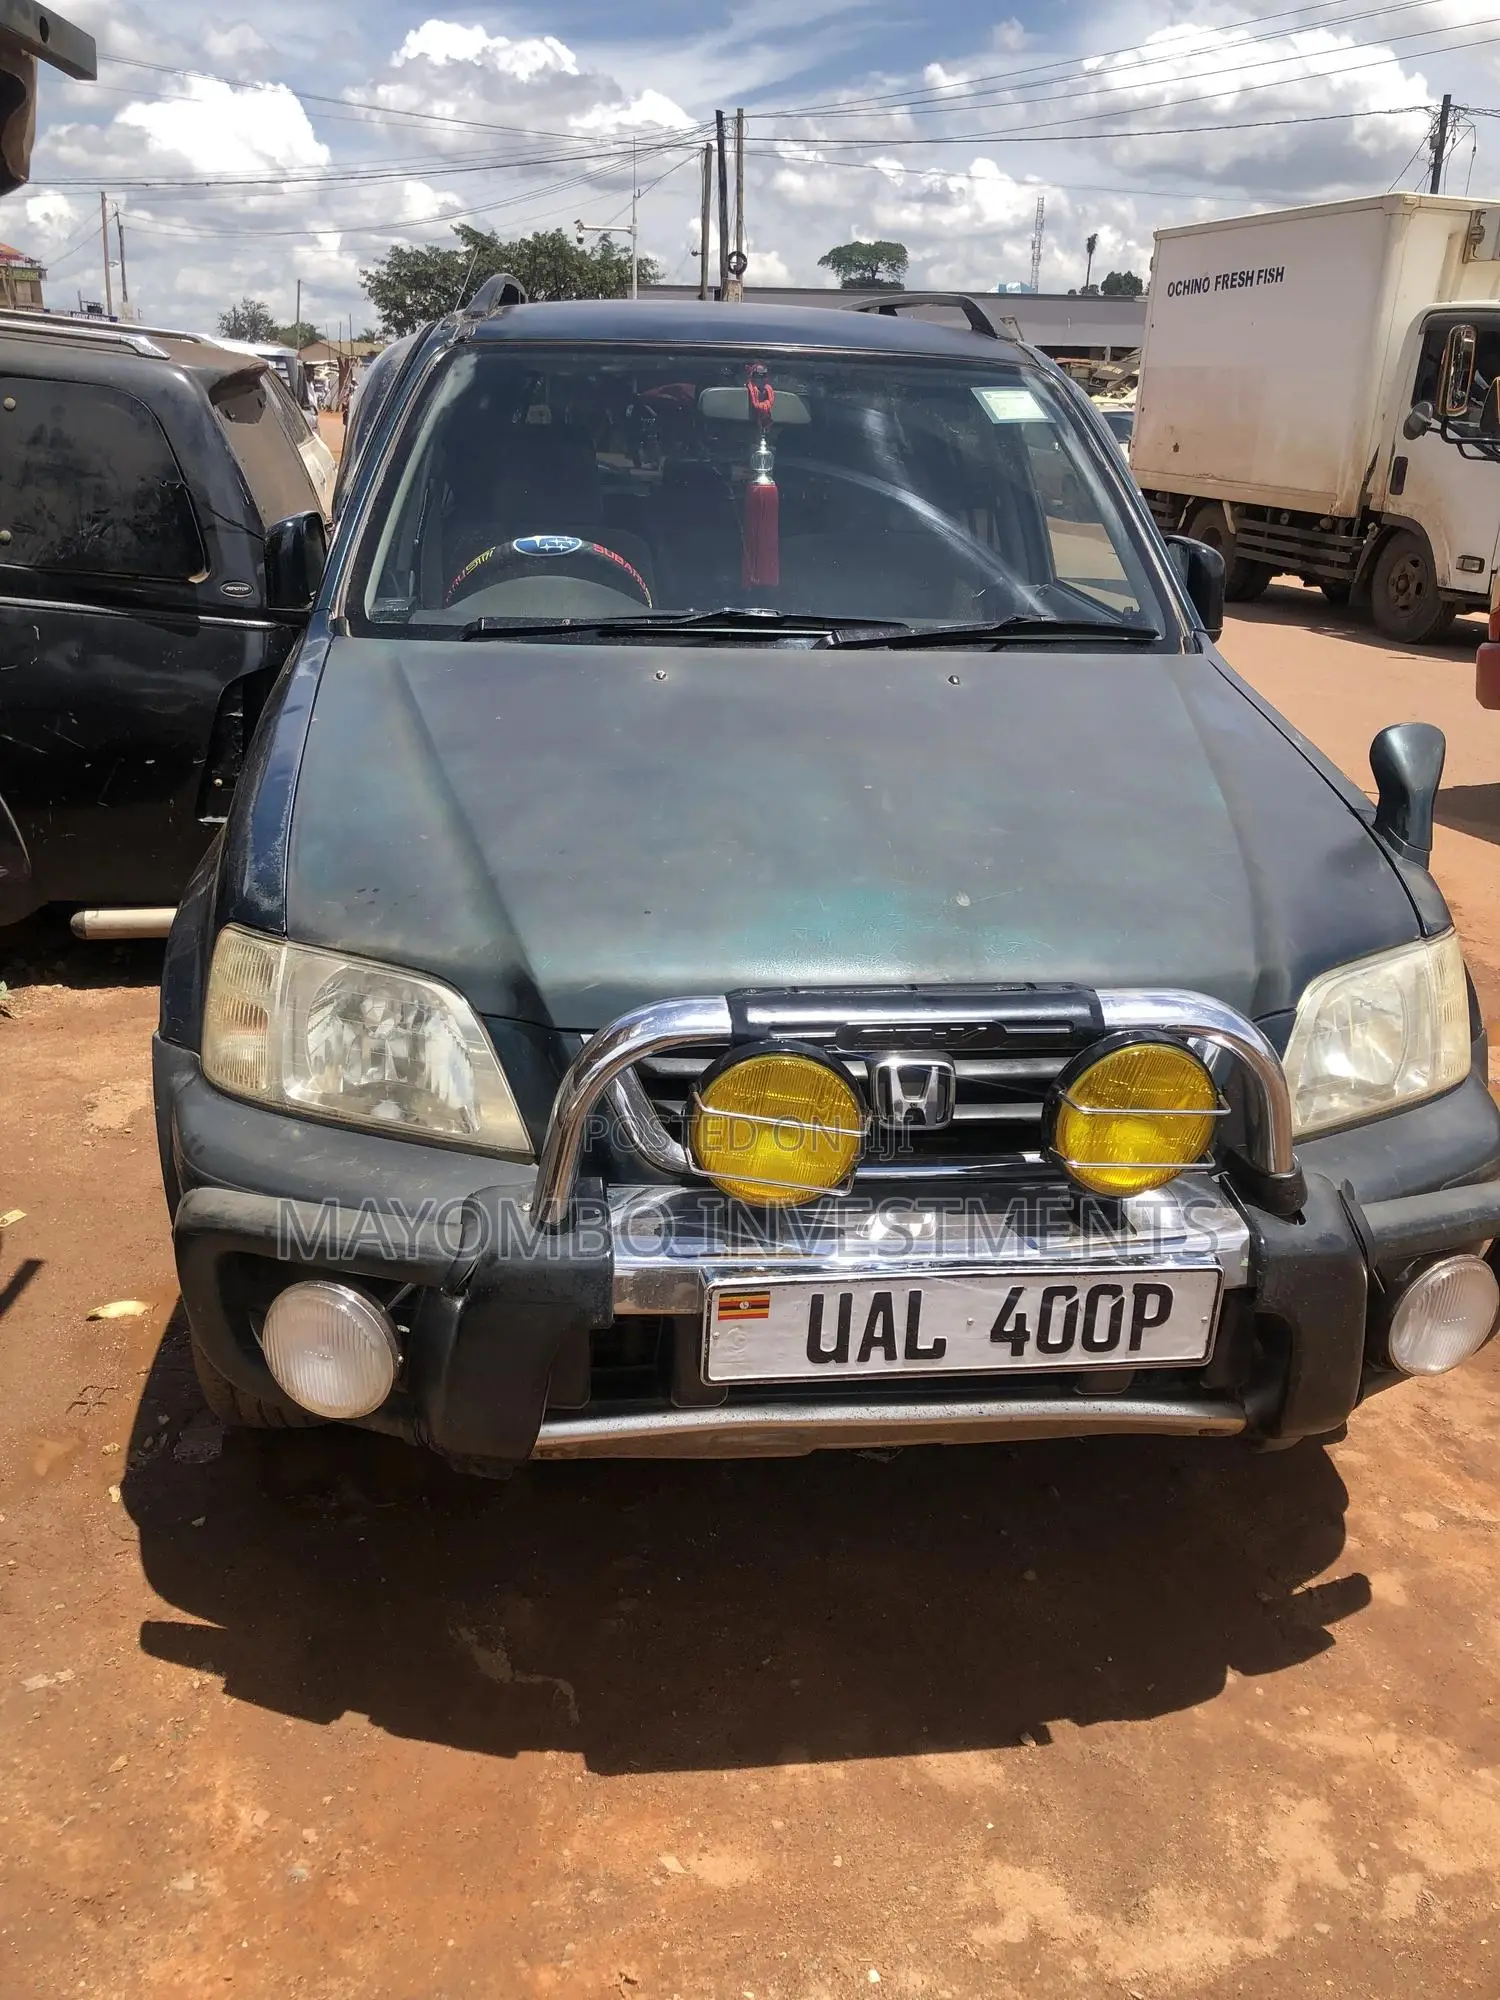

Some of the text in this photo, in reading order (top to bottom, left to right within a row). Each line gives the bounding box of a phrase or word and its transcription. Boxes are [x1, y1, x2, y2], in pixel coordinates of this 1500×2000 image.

[1167, 266, 1285, 297] OCHINO FRESH FISH
[805, 1283, 1174, 1364] UAL 400P
